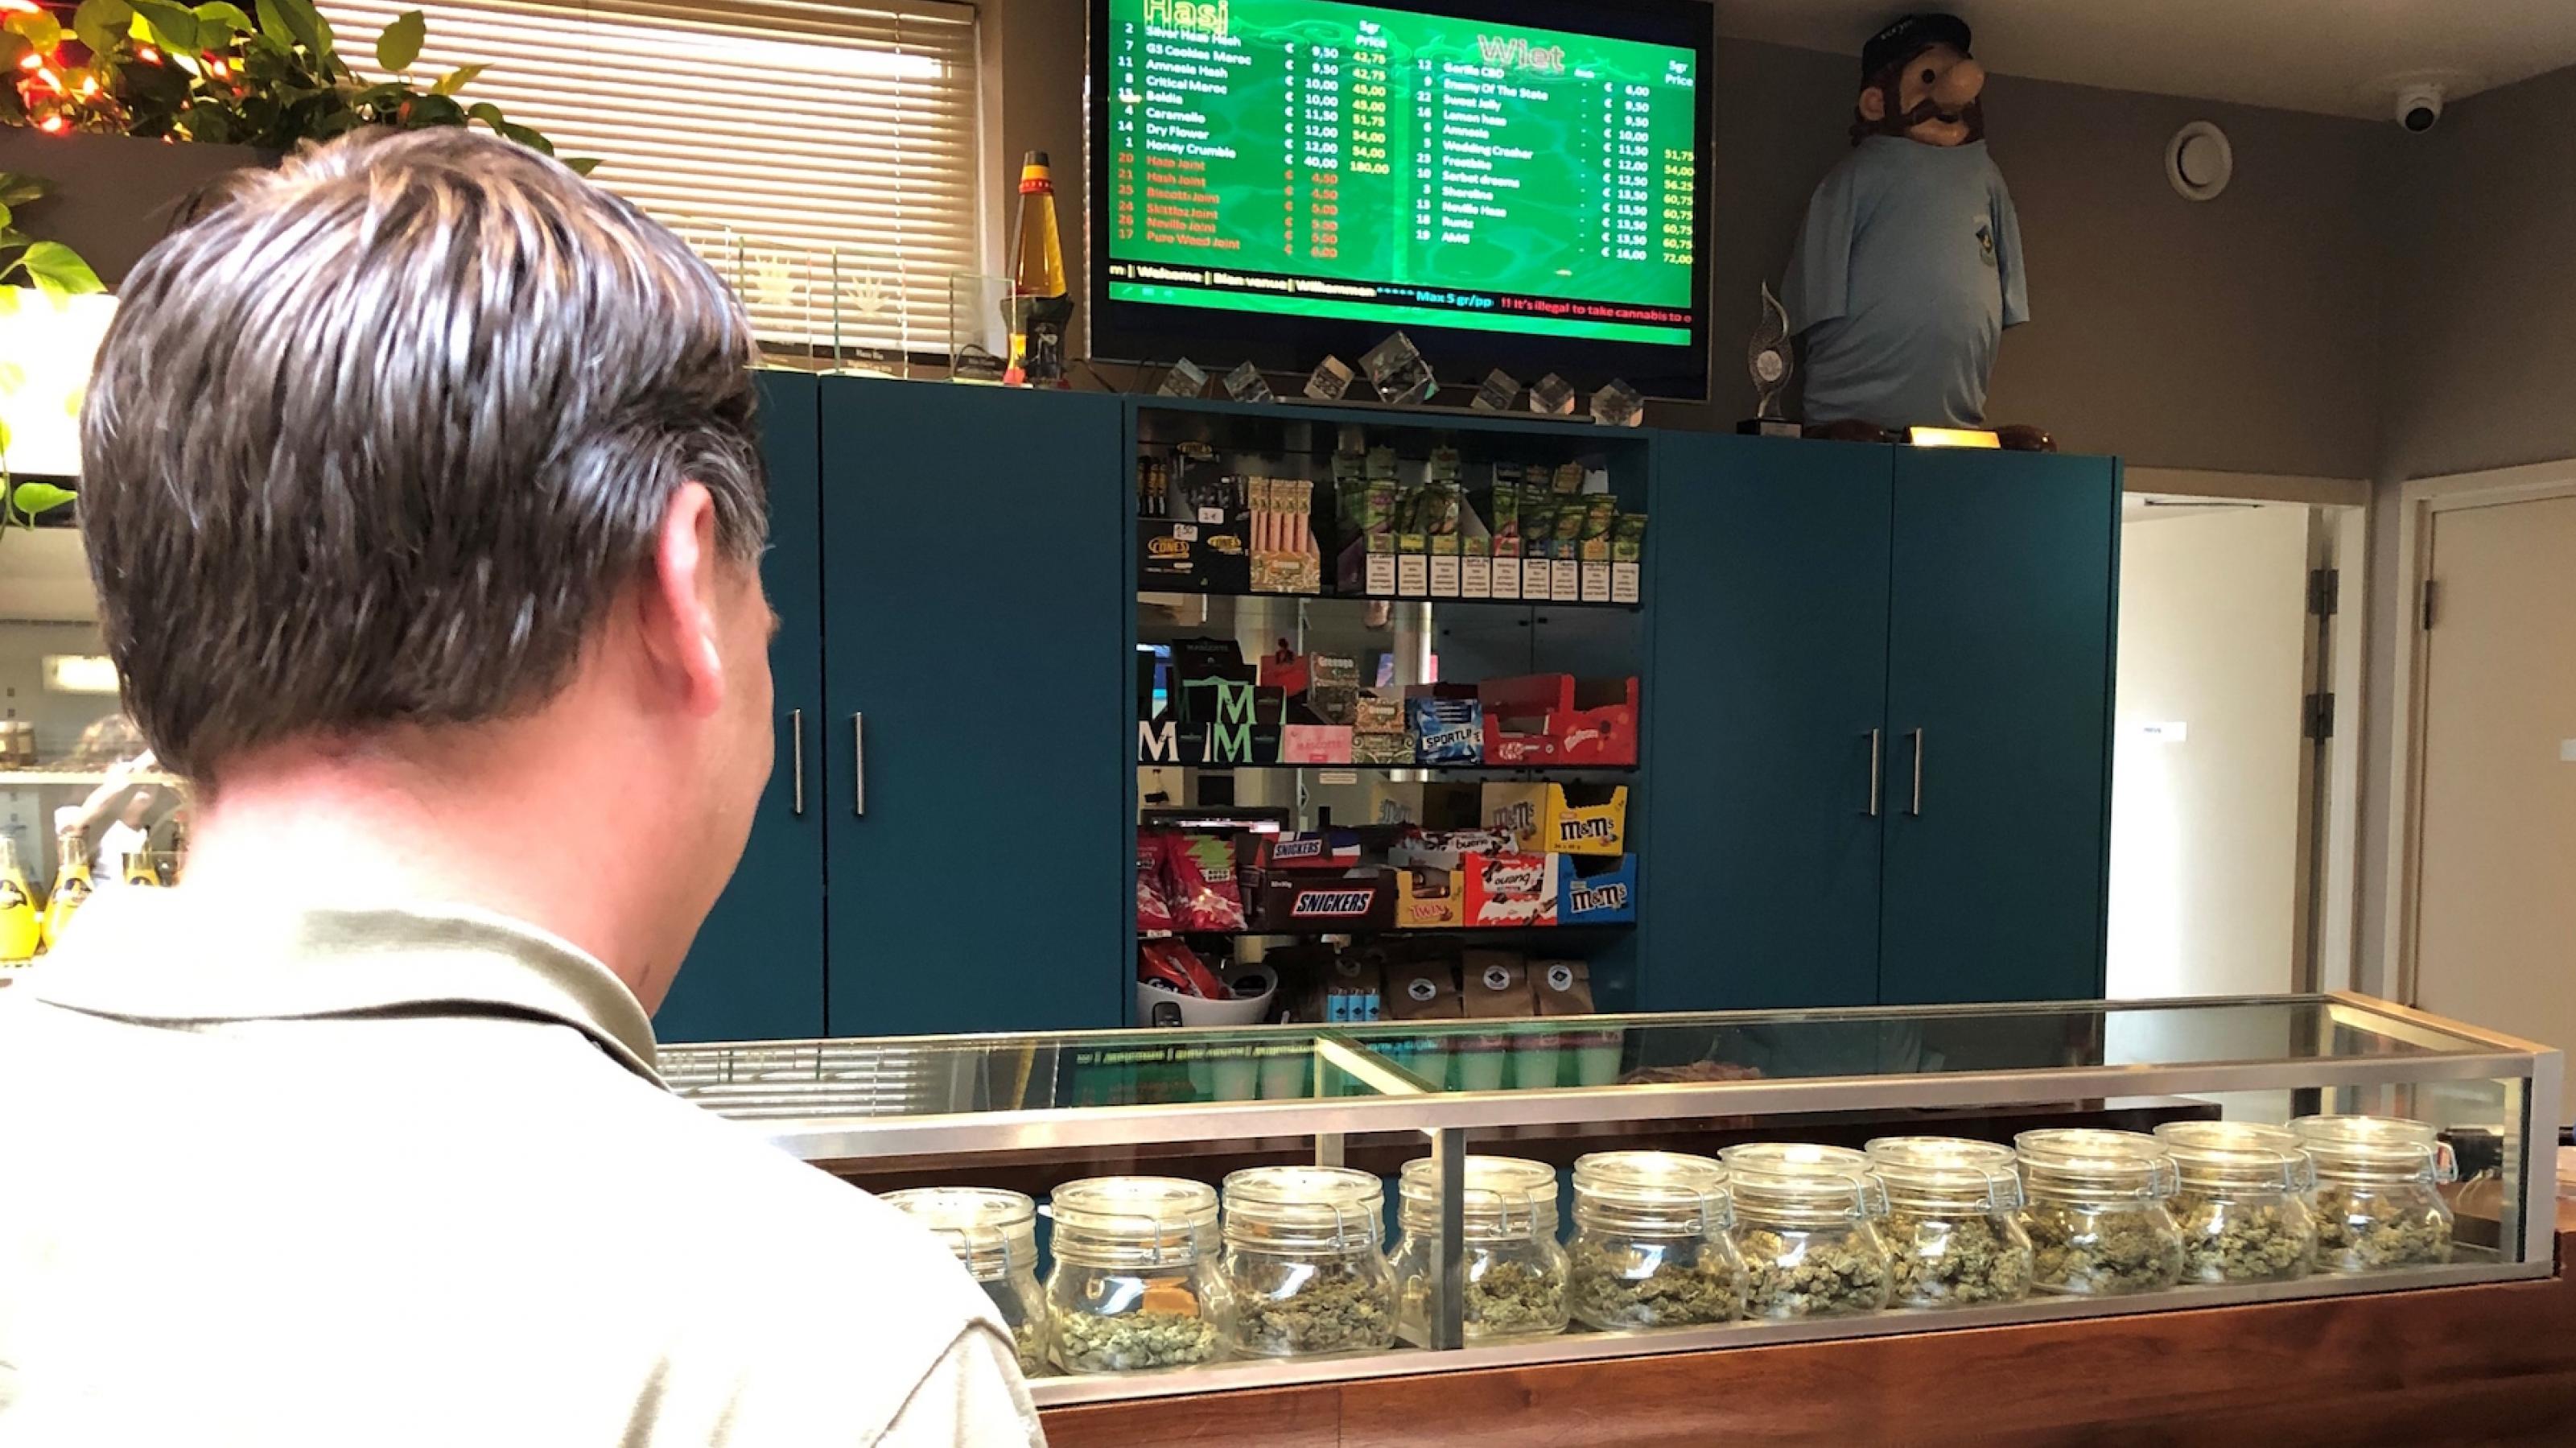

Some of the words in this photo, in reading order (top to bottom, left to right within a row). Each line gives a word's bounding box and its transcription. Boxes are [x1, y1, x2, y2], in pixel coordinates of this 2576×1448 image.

[1144, 0, 1228, 37] Hasj
[1125, 23, 1133, 34] 2
[1164, 44, 1210, 60] Cookies
[1213, 50, 1251, 65] Maroc
[1478, 35, 1564, 72] Wiet
[1119, 56, 1133, 68] 11
[1145, 59, 1197, 75] Amnesia
[1198, 65, 1228, 78] Hash
[1145, 76, 1189, 90] Critical
[1188, 80, 1227, 94] Maroc
[1665, 73, 1694, 87] Price
[1480, 83, 1496, 94] Of
[1497, 85, 1518, 97] The
[1519, 88, 1549, 101] State
[1124, 104, 1134, 116] 4
[1145, 107, 1206, 124] Caramello
[1119, 120, 1134, 132] 14
[1146, 123, 1168, 137] Dry
[1168, 126, 1210, 140] Flower
[1146, 139, 1185, 155] Honey
[1185, 143, 1236, 159] Crumble
[1665, 149, 1695, 162] 51,75
[1665, 164, 1695, 177] 54,00
[1663, 193, 1694, 206] 60,75
[1663, 208, 1694, 221] 60,75
[1663, 223, 1693, 236] 60,75
[1663, 237, 1693, 250] 60,75
[1663, 253, 1694, 265] 72,00
[1416, 291, 1445, 303] Max
[1446, 293, 1456, 303] 5
[1456, 294, 1493, 308] gr/pp
[1513, 299, 1534, 311] It's
[1533, 300, 1571, 315] illegal
[1572, 304, 1587, 315] to
[1587, 305, 1614, 317] take
[1615, 307, 1667, 321] cannabis
[1668, 312, 1683, 322] to
[1425, 728, 1482, 749] SPORTLIE
[1276, 842, 1320, 856] SNICKERS
[1296, 893, 1370, 912] SNICKERS
